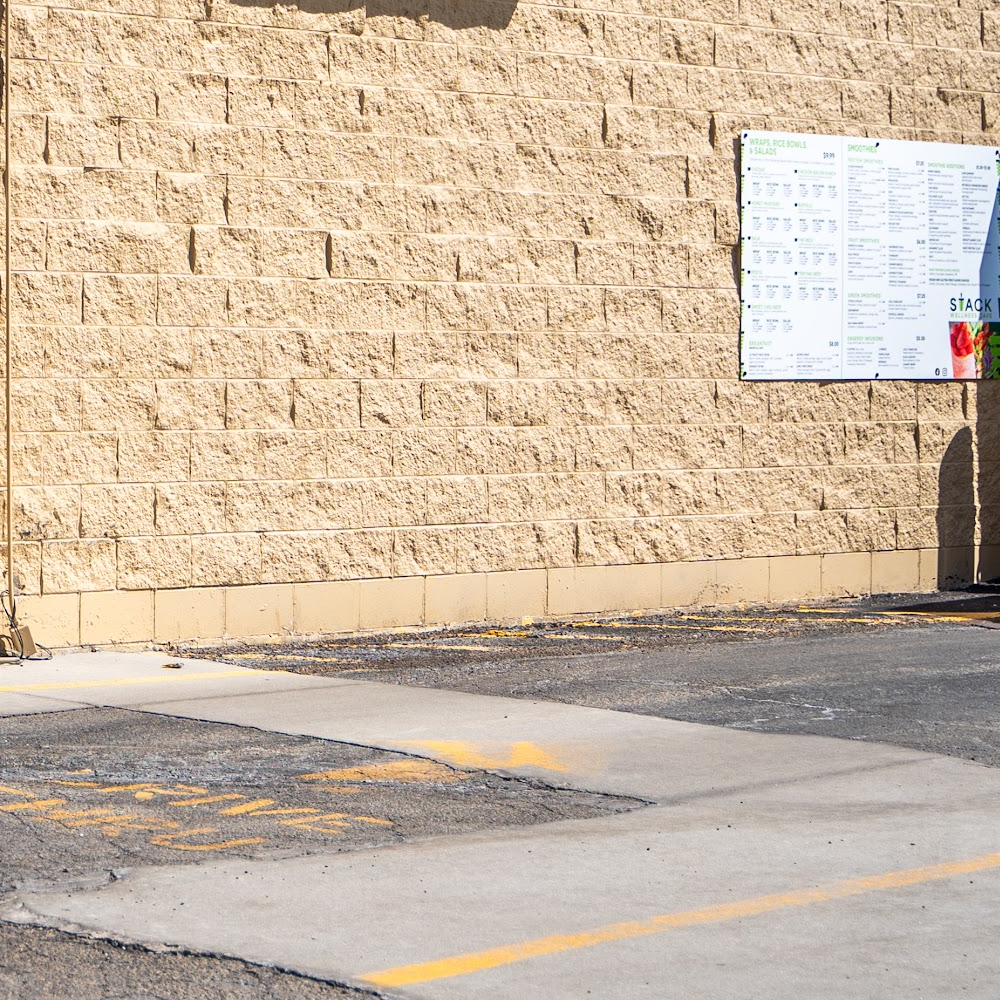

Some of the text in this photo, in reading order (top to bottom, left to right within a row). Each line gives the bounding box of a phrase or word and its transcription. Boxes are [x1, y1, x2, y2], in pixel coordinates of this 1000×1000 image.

[773, 139, 785, 147] RICE
[755, 148, 777, 156] SALADS
[848, 144, 877, 154] SMOOTHIES
[950, 292, 992, 312] STACK
